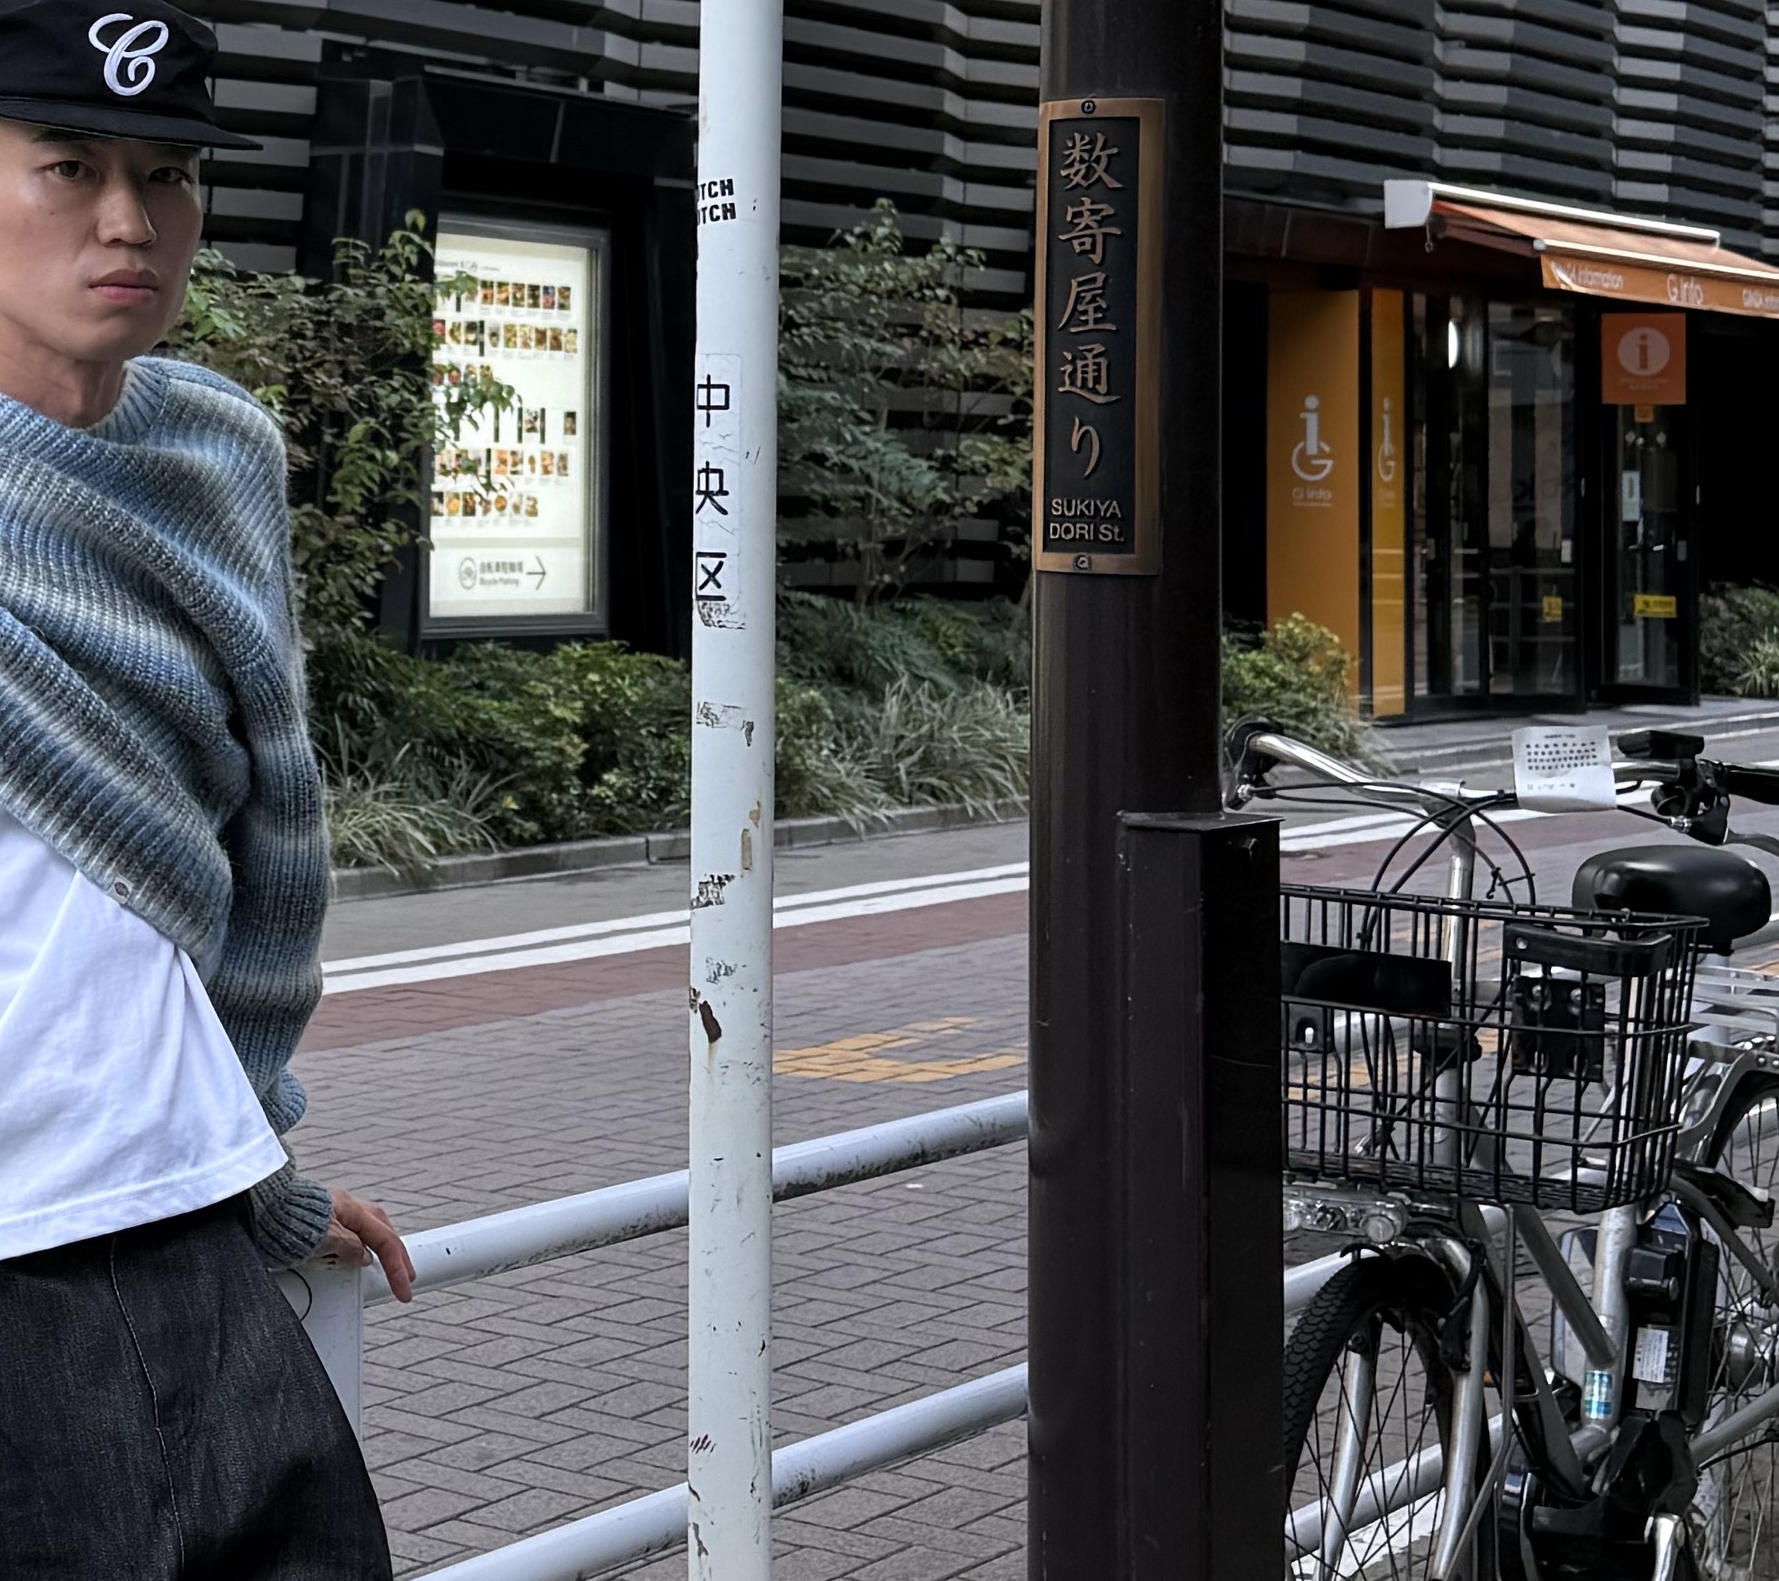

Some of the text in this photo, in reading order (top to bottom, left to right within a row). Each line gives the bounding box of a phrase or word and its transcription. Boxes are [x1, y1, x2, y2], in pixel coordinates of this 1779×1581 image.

[697, 178, 734, 201] TCH
[696, 202, 737, 225] TCH
[1057, 130, 1125, 479] 数寄屋通り
[695, 374, 730, 603] 中央区
[1051, 497, 1122, 518] SUKIYA
[1049, 522, 1095, 540] DORI
